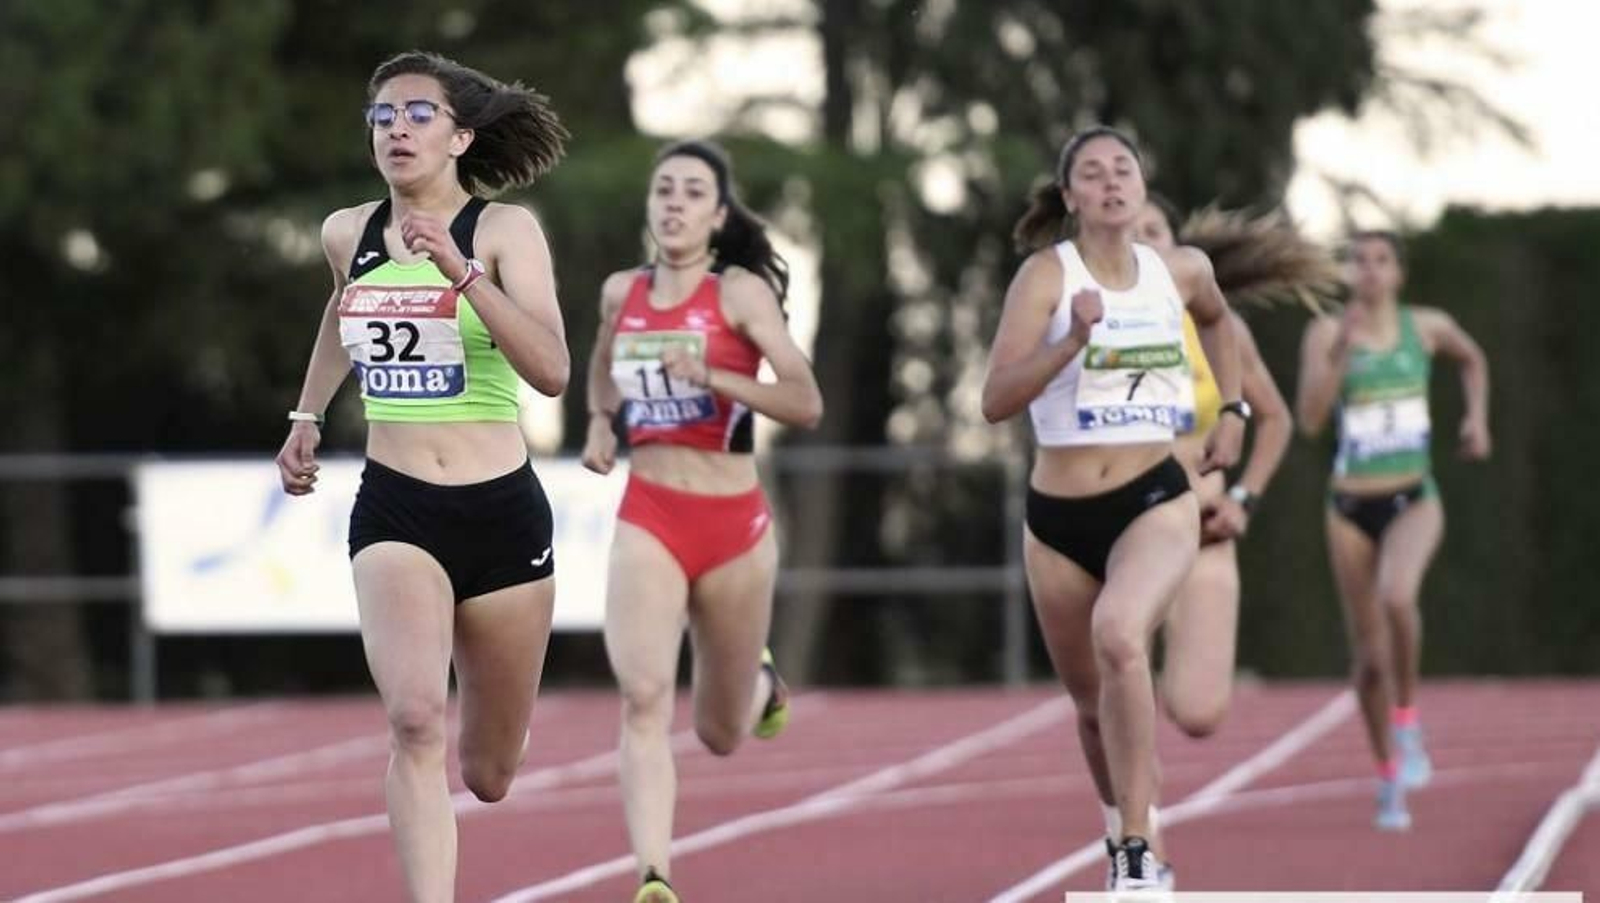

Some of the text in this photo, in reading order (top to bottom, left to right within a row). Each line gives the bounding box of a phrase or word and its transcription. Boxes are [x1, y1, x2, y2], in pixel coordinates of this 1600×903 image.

[366, 320, 426, 362] 32
[635, 366, 673, 398] 11
[1126, 370, 1147, 401] 7
